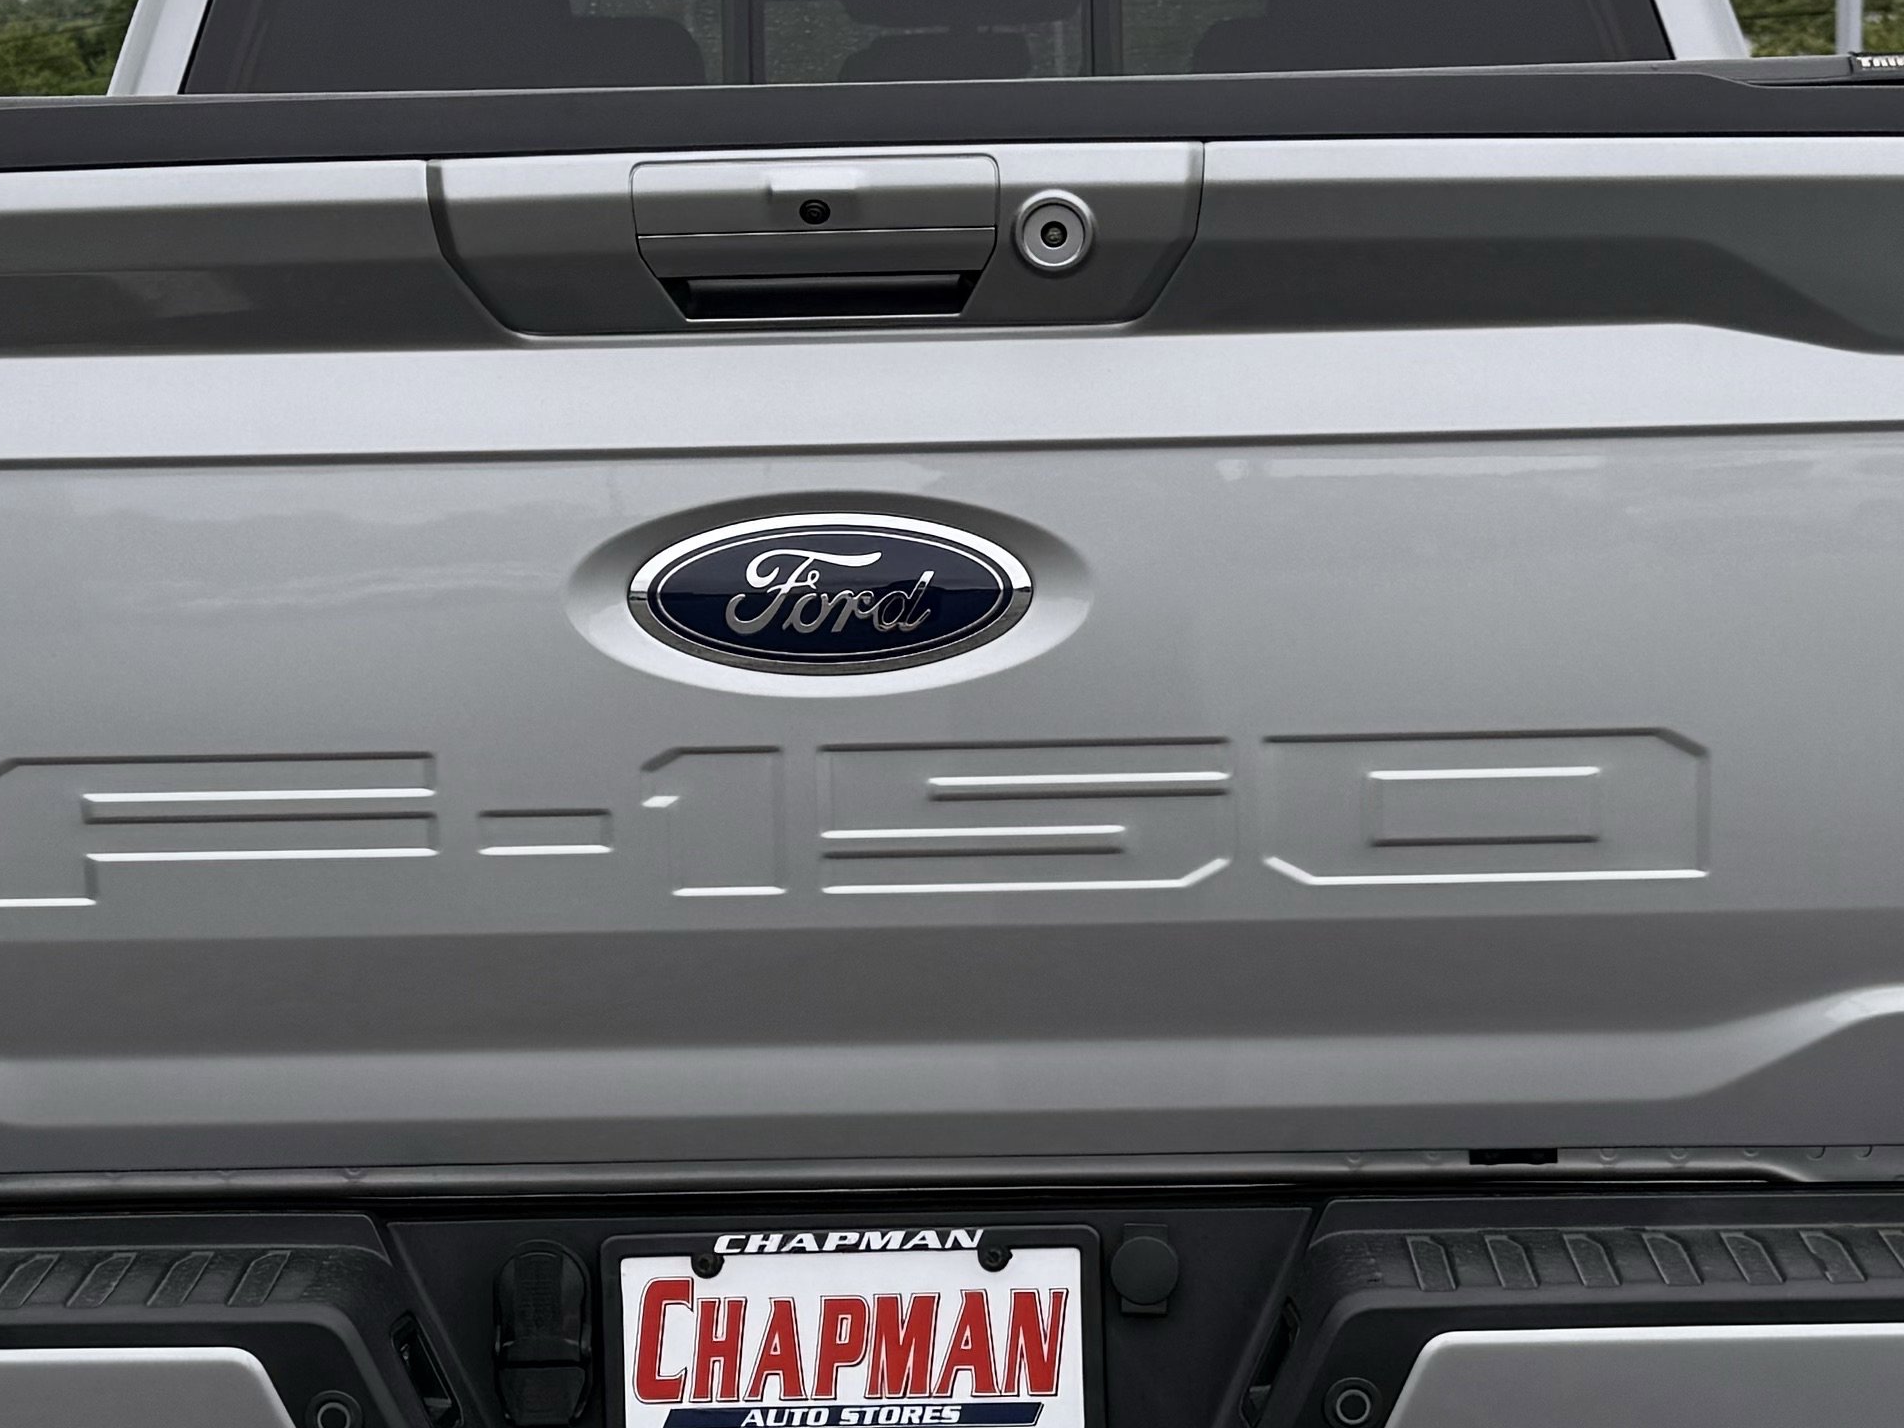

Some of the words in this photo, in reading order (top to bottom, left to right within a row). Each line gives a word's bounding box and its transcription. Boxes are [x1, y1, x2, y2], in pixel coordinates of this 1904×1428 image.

[724, 548, 935, 635] Ford
[713, 1229, 984, 1254] CHAPMAN
[632, 1275, 1070, 1405] CHAPMAN
[740, 1408, 829, 1428] AUTO
[839, 1405, 962, 1425] STORES
